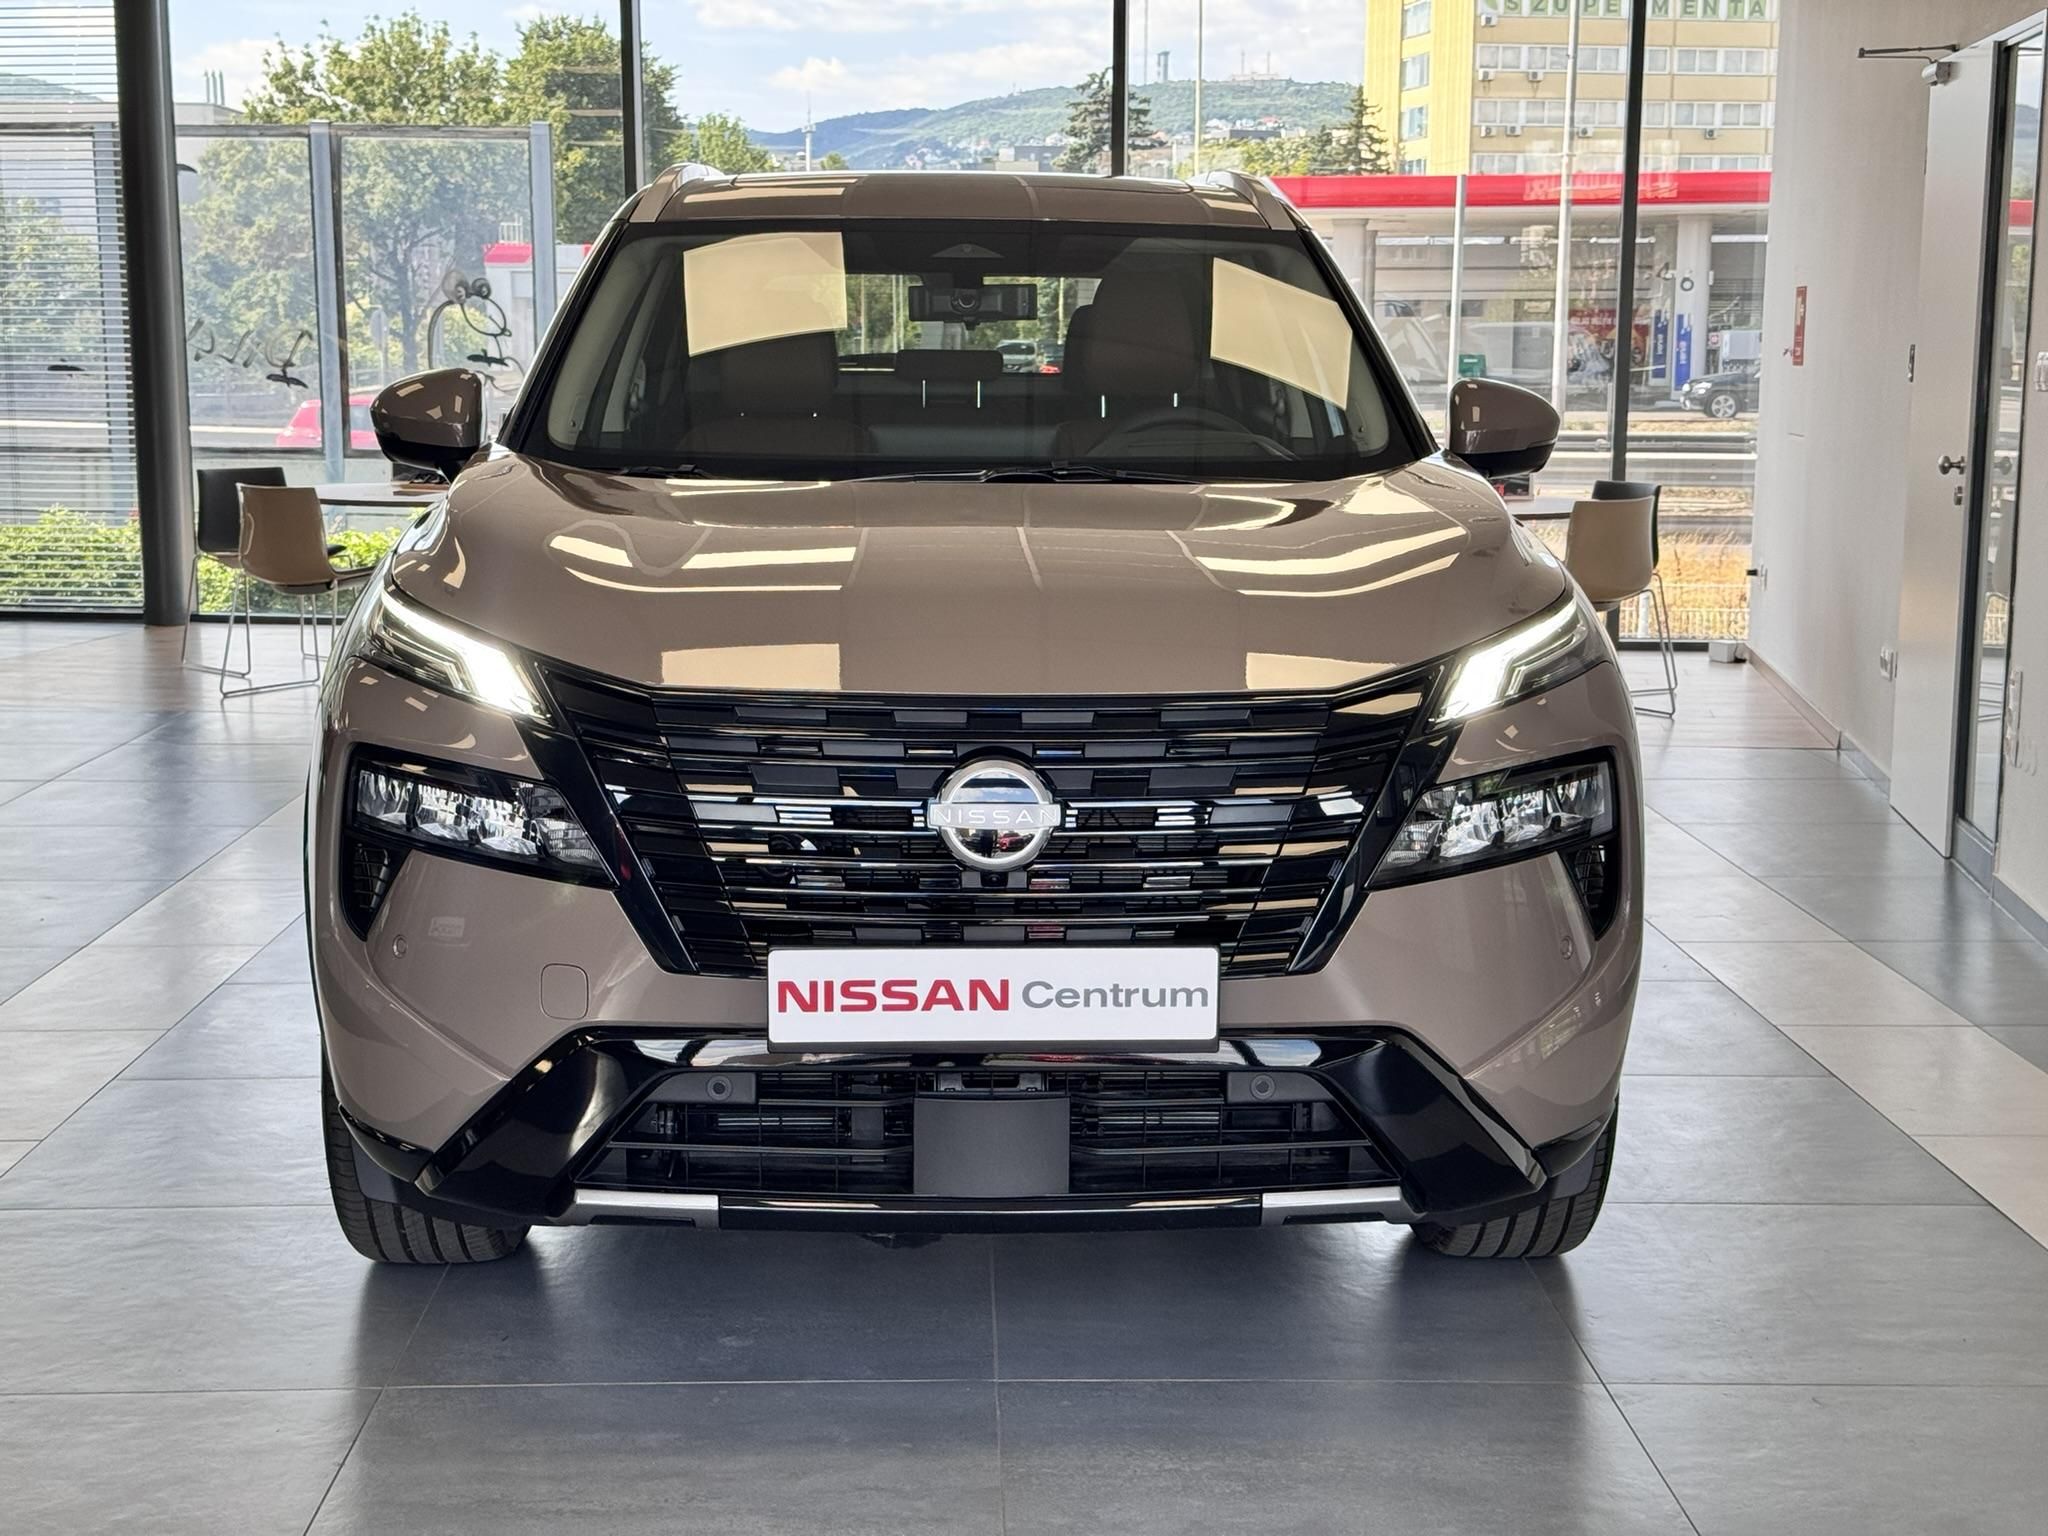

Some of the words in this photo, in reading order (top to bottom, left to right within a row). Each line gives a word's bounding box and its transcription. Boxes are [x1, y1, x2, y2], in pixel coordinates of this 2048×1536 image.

[932, 808, 1057, 825] NISSAN
[777, 979, 1010, 1013] NISSAN
[1021, 980, 1209, 1009] Centrum
